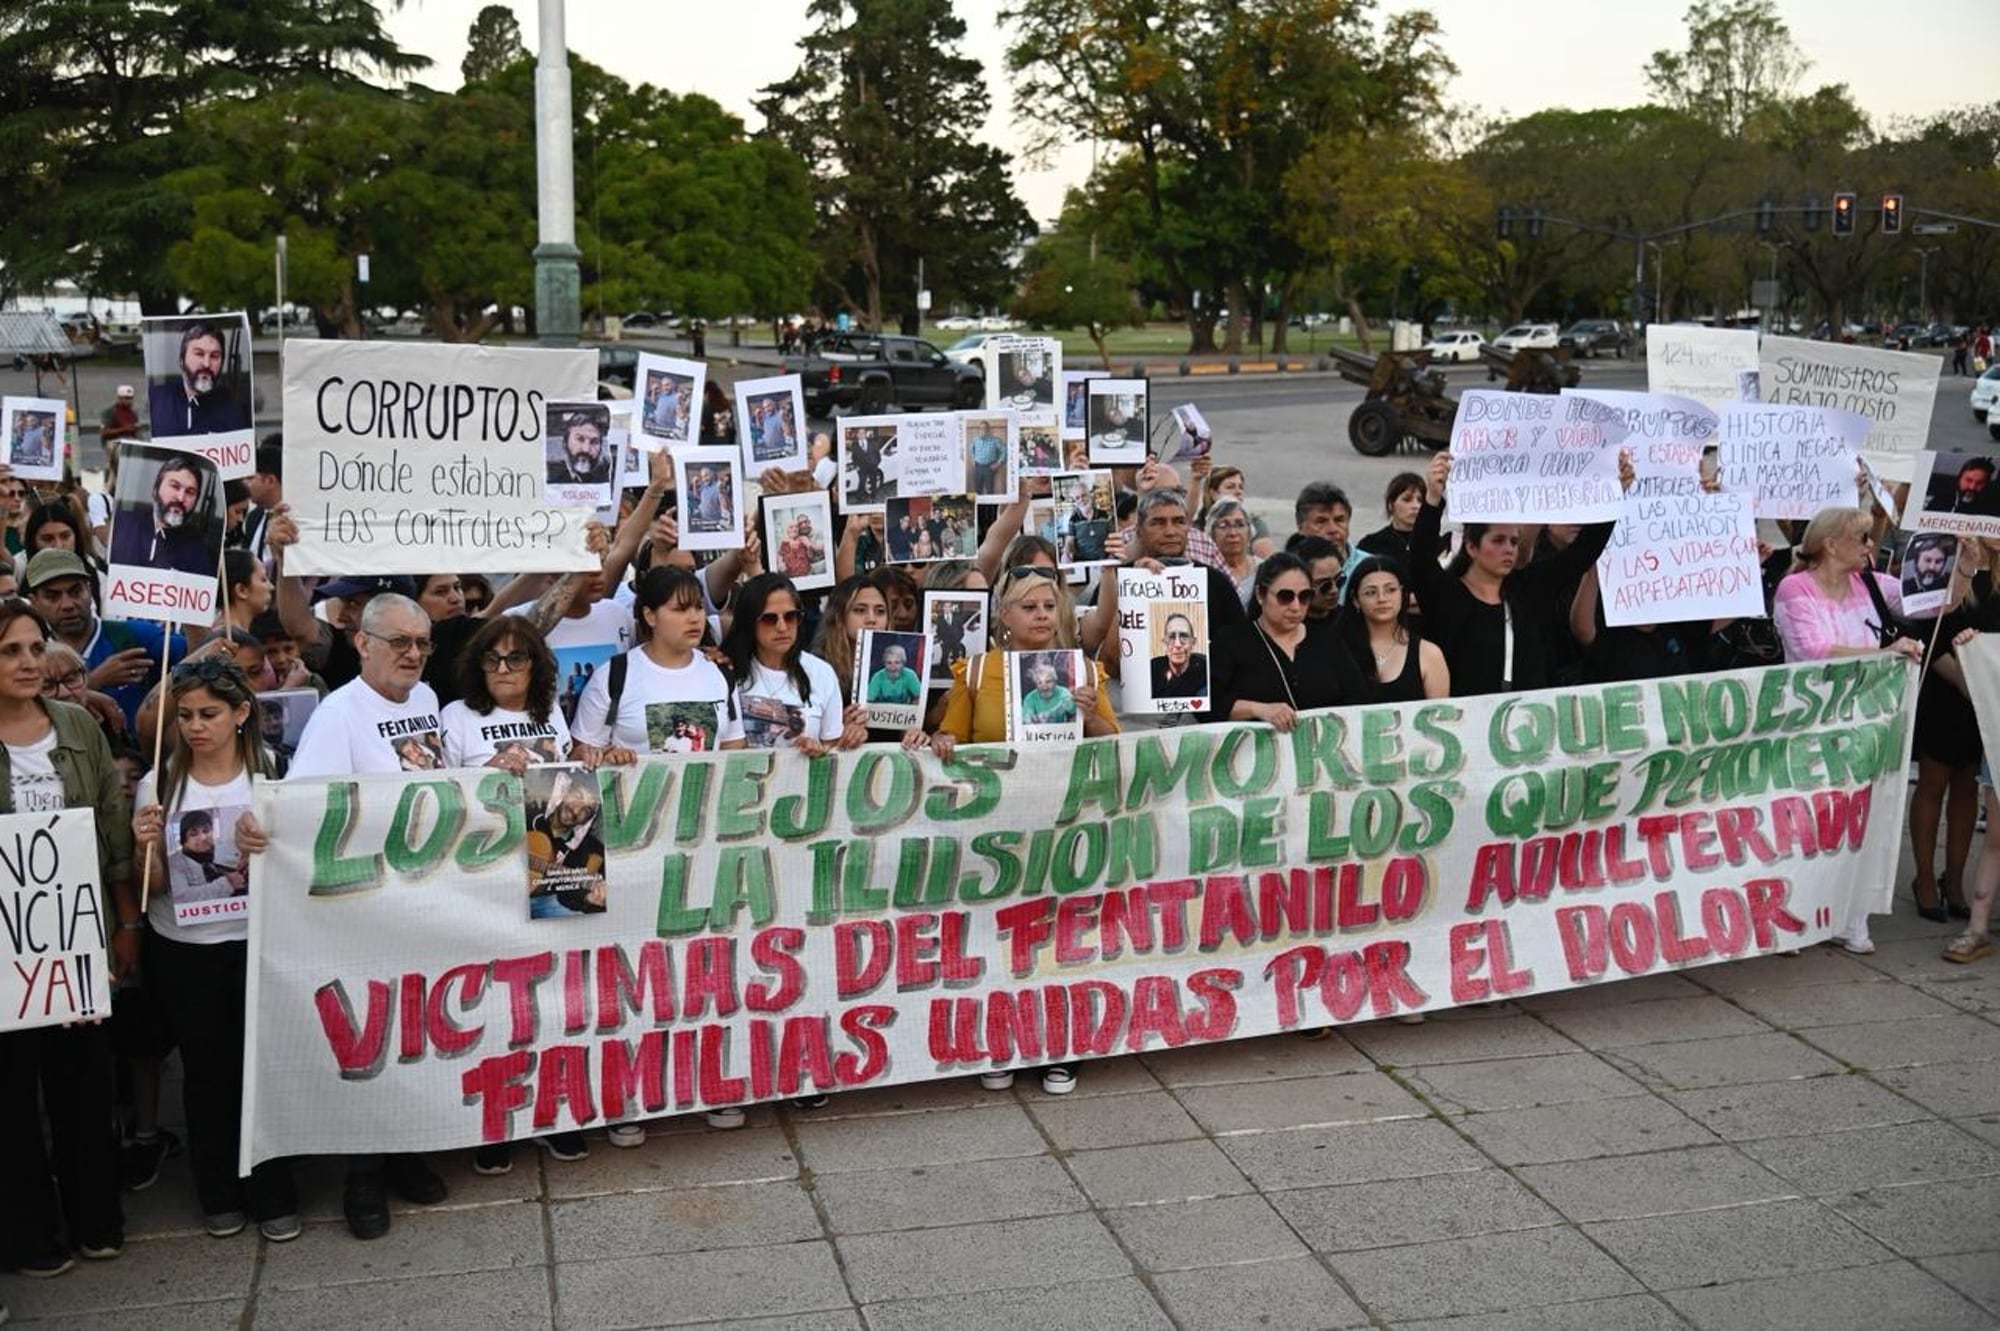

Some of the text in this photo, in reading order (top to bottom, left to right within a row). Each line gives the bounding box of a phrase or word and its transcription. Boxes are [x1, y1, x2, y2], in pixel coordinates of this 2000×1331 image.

[316, 376, 544, 442] CORRUPTOS
[1463, 395, 1553, 423] DONDE
[1727, 411, 1826, 438] HISTORIA
[1530, 424, 1547, 448] Y
[200, 442, 251, 468] SINO
[1539, 450, 1595, 478] HAY
[319, 449, 536, 499] Dónde estaban
[1628, 475, 1697, 498] ONTROLES
[1730, 466, 1748, 486] LA
[1638, 500, 1667, 520] LAS
[1676, 494, 1742, 516] VOCES
[1648, 514, 1740, 543] CALLARON
[1623, 550, 1660, 579] LAS
[1669, 538, 1727, 567] VIDAS
[109, 579, 212, 613] ASESINO
[1613, 565, 1751, 611] ARREBATARON
[308, 771, 527, 898] LOS
[600, 745, 1018, 856] VIEJOS
[1056, 703, 1468, 829] AMORES
[1487, 685, 1651, 769] QUE
[1657, 676, 1752, 747] NO
[656, 842, 781, 939] LA
[1188, 796, 1288, 876] DE
[1306, 779, 1468, 865] LOS
[1484, 759, 1624, 842] QUE
[178, 901, 248, 918] JUSTICI
[312, 783, 1873, 1081] VICTIMAS DEL FENTANILO ADULTERADO
[14, 952, 96, 1020] YA!!
[460, 1003, 898, 1142] FAMILIAS
[927, 966, 1246, 1071] UNIDAS
[1262, 939, 1433, 1031] POR
[1449, 917, 1537, 1003] EL
